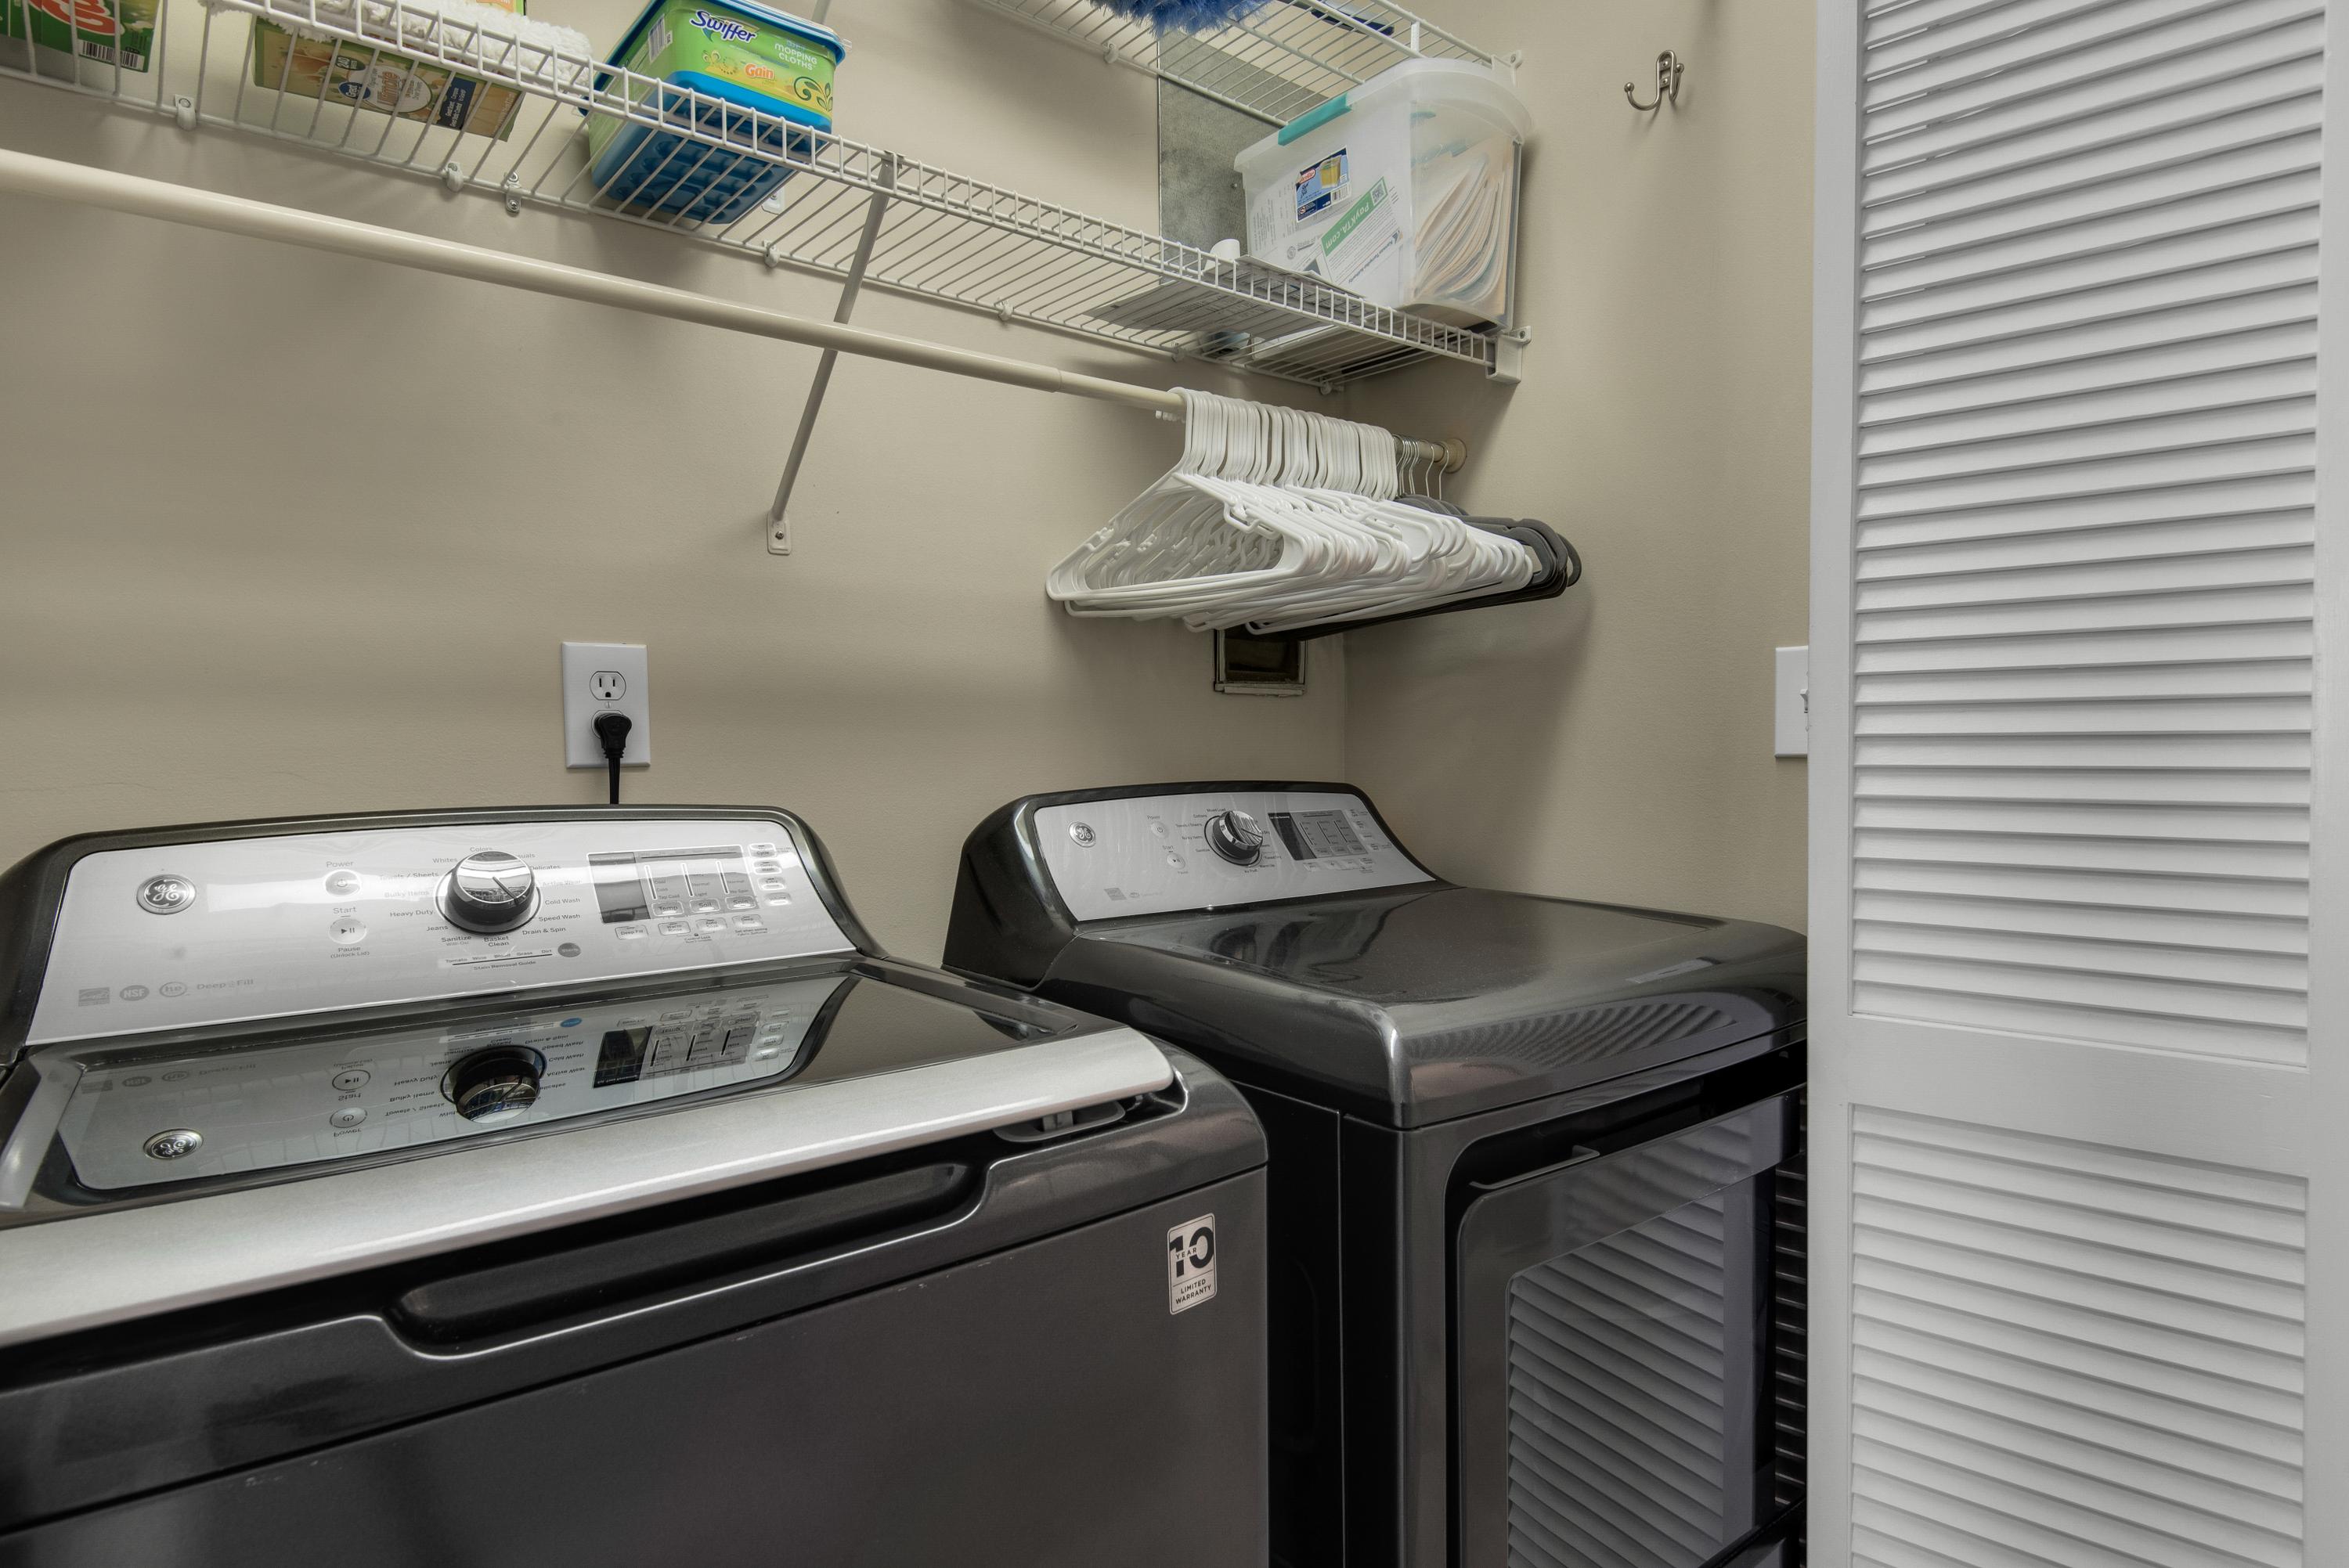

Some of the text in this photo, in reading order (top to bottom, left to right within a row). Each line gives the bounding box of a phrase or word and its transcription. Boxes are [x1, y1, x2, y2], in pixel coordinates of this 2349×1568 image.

[691, 10, 756, 43] Swiffer
[337, 56, 350, 68] 240
[778, 52, 814, 70] CLOTHS
[744, 63, 775, 80] Gain
[1326, 202, 1369, 249] PayKTA.com
[124, 988, 146, 999] NSF
[1170, 1227, 1214, 1278] 10
[1176, 1248, 1197, 1260] YEAR
[1176, 1285, 1211, 1304] WARRANTY
[1181, 1278, 1206, 1294] LIMITED
